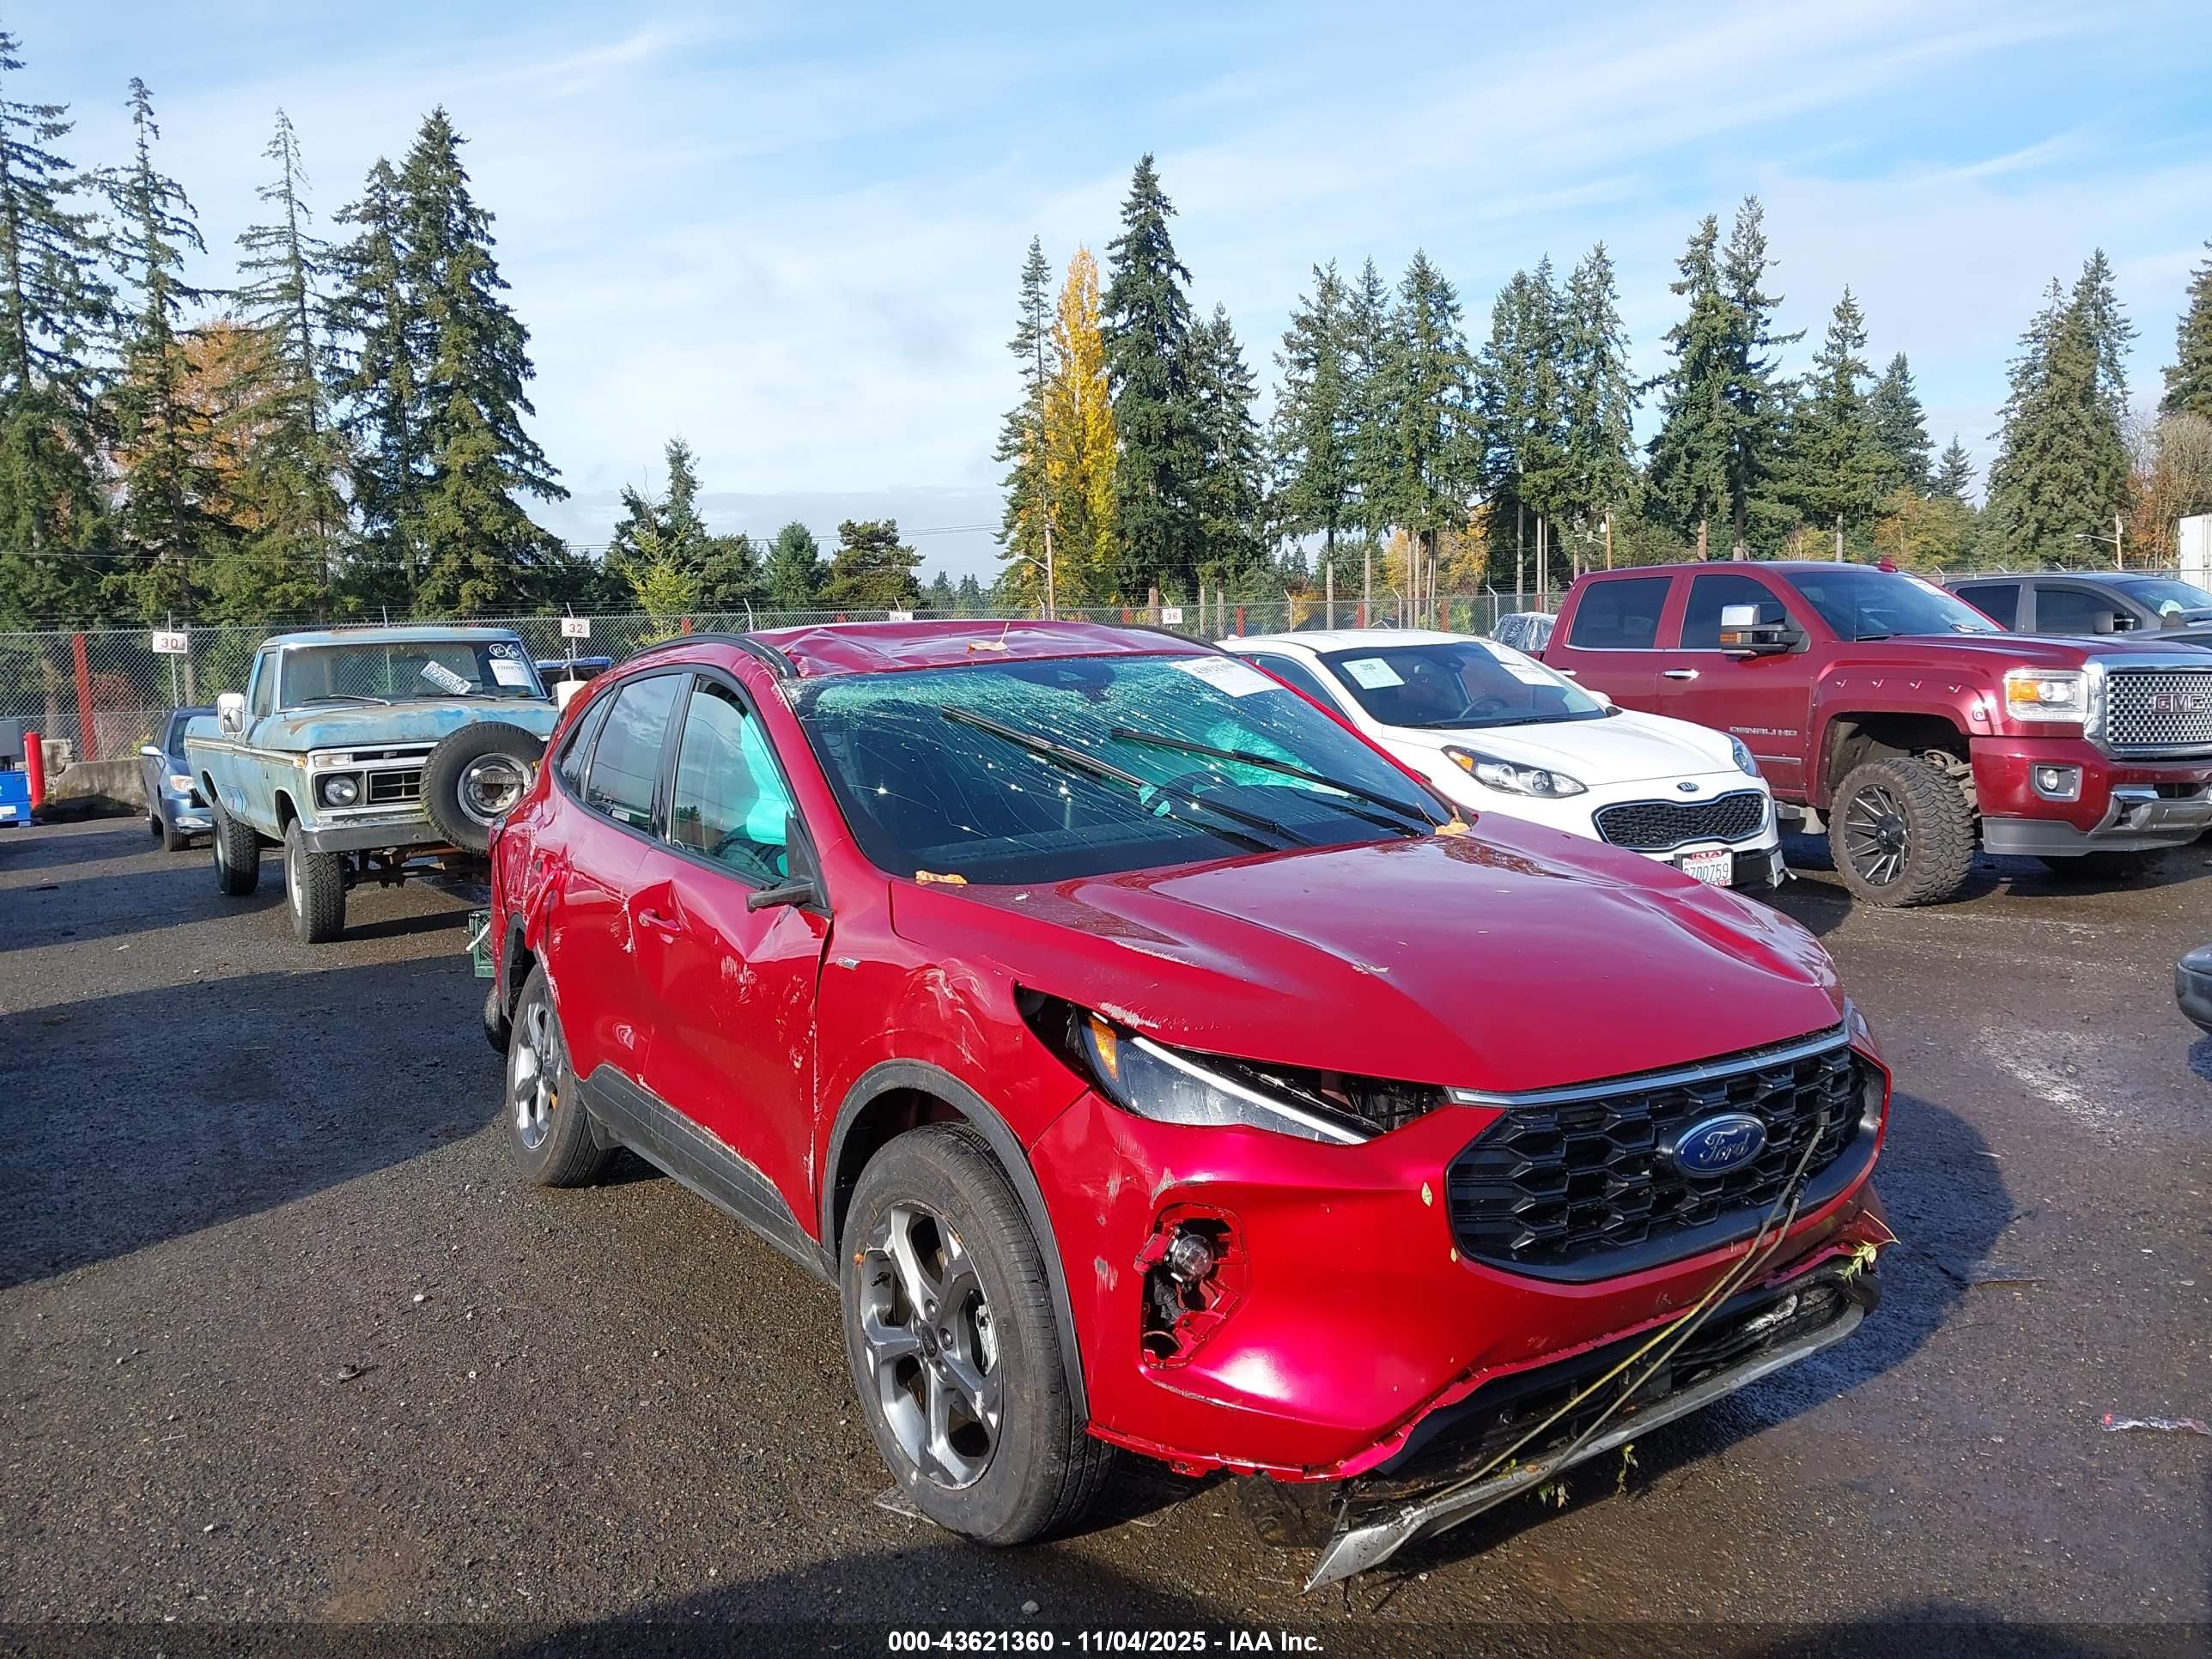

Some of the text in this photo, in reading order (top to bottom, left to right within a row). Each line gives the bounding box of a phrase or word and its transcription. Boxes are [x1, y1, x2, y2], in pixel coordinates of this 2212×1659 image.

[1167, 612, 1178, 621] 36
[569, 623, 583, 634] 32
[161, 637, 179, 649] 30
[2153, 693, 2204, 714] GMC
[1729, 726, 1777, 736] DENALI
[1699, 1128, 1749, 1162] Ford
